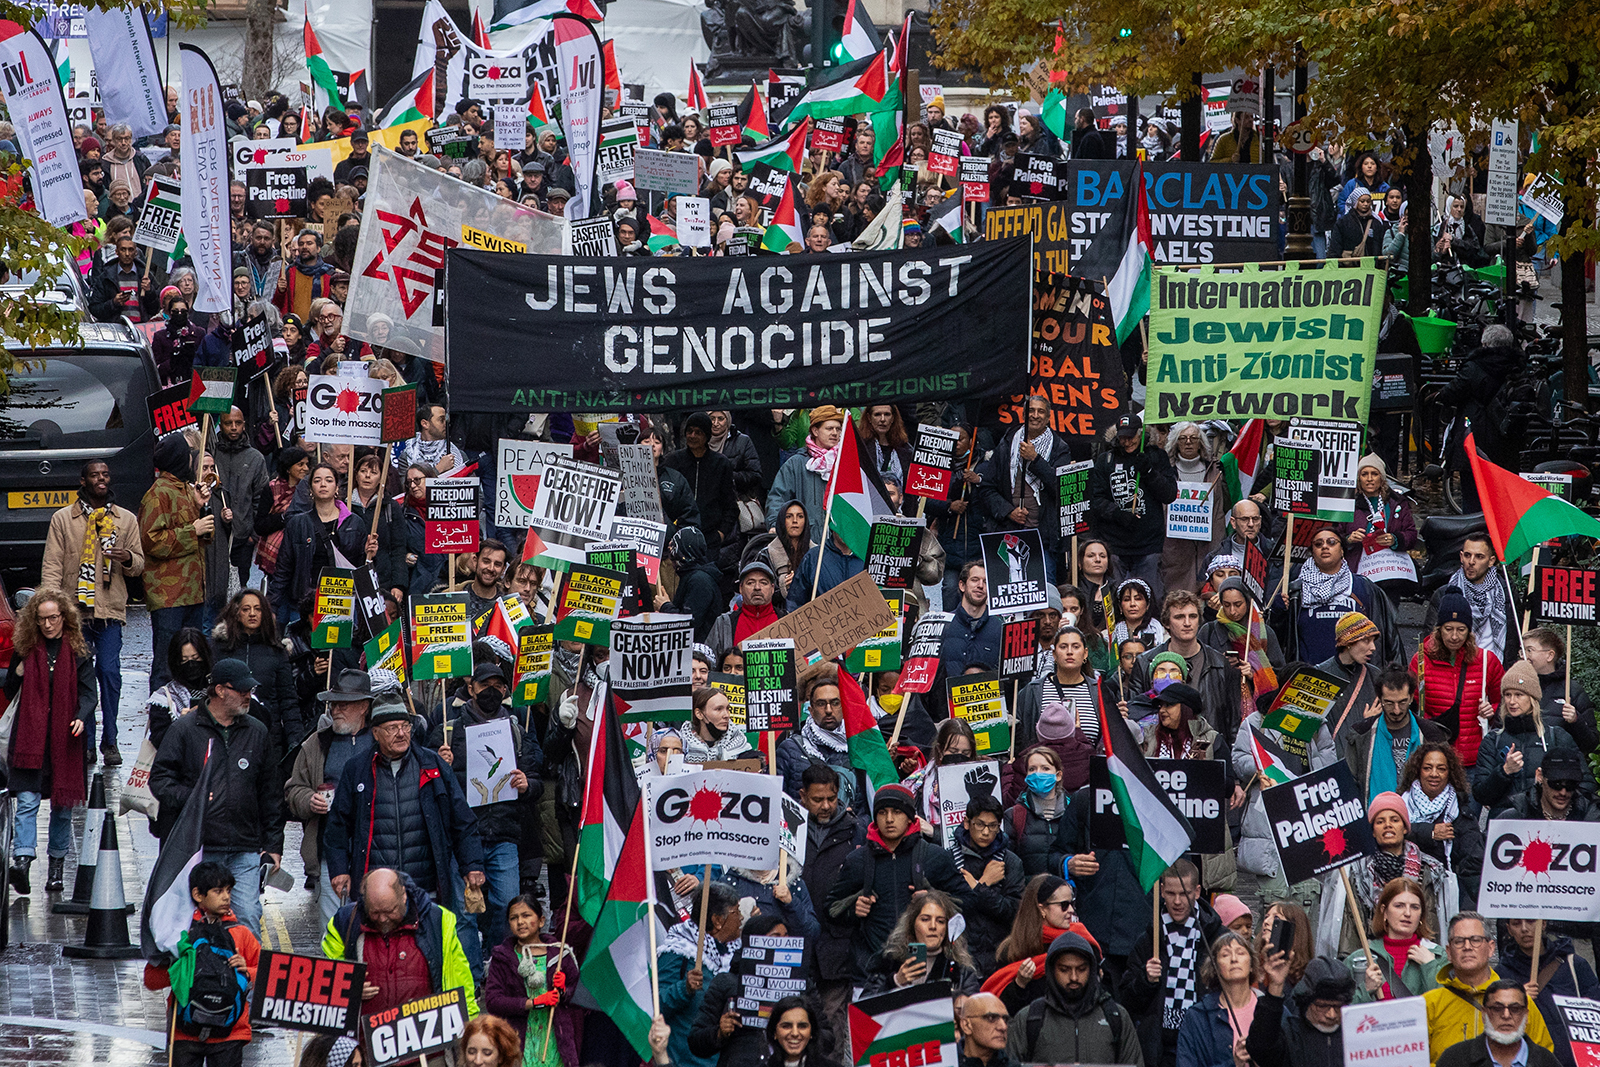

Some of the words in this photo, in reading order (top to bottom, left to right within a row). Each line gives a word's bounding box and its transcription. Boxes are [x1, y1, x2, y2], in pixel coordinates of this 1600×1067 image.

[124, 11, 136, 38] Jewish
[131, 39, 145, 74] Network
[140, 74, 148, 88] for
[144, 88, 157, 126] Palestine
[922, 87, 930, 96] NO
[28, 106, 53, 122] ALWAYS
[622, 107, 648, 116] FREEDOM
[710, 107, 736, 116] FREEDOM
[710, 117, 738, 127] PALESTINE
[816, 121, 844, 134] PALESTINE
[934, 134, 960, 146] FREEDOM
[1496, 132, 1502, 144] P
[931, 144, 960, 157] PALESTINE
[285, 154, 306, 162] STOP
[1028, 156, 1054, 172] Free
[962, 162, 988, 172] FREEDOM
[42, 172, 73, 188] oppressor
[266, 171, 296, 186] Free
[961, 172, 988, 182] PALESTINE
[249, 185, 306, 200] Palestine
[142, 204, 181, 230] FREE
[138, 221, 178, 238] PALESTINE
[464, 229, 525, 253] JEWISH
[525, 264, 676, 315] JEWS
[722, 254, 972, 315] AGAINST
[1159, 274, 1374, 310] International
[243, 320, 266, 344] Free
[1156, 314, 1364, 344] Jewish
[604, 317, 892, 374] GENOCIDE
[1040, 342, 1053, 353] the
[1156, 350, 1365, 384] Anti-Zionist
[511, 388, 632, 407] ANTI-NAZI
[644, 386, 808, 406] ANTI-FASCIST
[818, 372, 972, 400] ANTI-ZIONIST
[1158, 390, 1360, 420] Network
[153, 398, 196, 434] FREE
[310, 416, 330, 427] Stop
[332, 418, 346, 426] the
[348, 419, 381, 429] massac
[918, 434, 954, 452] FREEDOM
[620, 446, 634, 458] END
[638, 447, 651, 460] THE
[914, 450, 952, 468] PALESTINE
[1276, 446, 1296, 459] FROM
[1298, 449, 1313, 460] THE
[1276, 457, 1296, 470] RIVER
[1298, 460, 1308, 470] TO
[1276, 467, 1288, 480] THE
[1289, 470, 1304, 480] SEA
[543, 467, 618, 504] CEASEFIRE
[622, 476, 656, 490] CLEANSING
[1275, 478, 1314, 492] PALESTINE
[23, 492, 40, 505] S4
[44, 492, 69, 504] VAM
[430, 488, 474, 500] FREEDOM
[644, 491, 654, 500] THE
[544, 490, 606, 531] NOW!
[1060, 500, 1091, 517] PALESTINE
[1170, 503, 1210, 514] ISRAEL'S
[1274, 498, 1291, 511] FREE
[428, 506, 476, 519] PALESTINE
[1169, 513, 1210, 524] GENOCIDAL
[436, 524, 468, 536] الحرية
[616, 524, 660, 542] FREEDOM
[875, 524, 900, 537] FROM
[902, 527, 917, 538] THE
[1060, 526, 1075, 538] FREE
[1169, 524, 1188, 533] LAND
[1189, 526, 1209, 534] GRAB
[873, 534, 894, 546] RIVER
[896, 536, 910, 547] TO
[872, 544, 888, 555] THE
[888, 546, 904, 557] SEA
[869, 554, 913, 568] PALESTINE
[868, 564, 886, 576] WILL
[888, 566, 901, 577] BE
[325, 578, 348, 586] BLACK
[578, 574, 612, 588] BLACK
[996, 580, 1039, 596] FREE
[1542, 568, 1596, 604] FREE
[320, 587, 352, 596] LIBERATION:
[328, 598, 344, 606] FREE
[579, 592, 604, 606] FREE
[992, 590, 1046, 608] PALESTINE
[319, 606, 350, 614] PALESTINE!
[424, 606, 457, 614] BLACK
[566, 600, 612, 616] PALESTINE!
[1542, 602, 1596, 620] PALESTINE
[416, 614, 466, 622] LIBERATION:
[430, 626, 454, 634] FREE
[526, 634, 548, 645] BLACK
[613, 630, 690, 654] CEASEFIRE
[746, 642, 768, 650] Socialist
[1004, 620, 1036, 659] FREE
[746, 651, 769, 664] FROM
[771, 650, 788, 664] THE
[621, 650, 682, 680] NOW!
[747, 664, 772, 678] RIVER
[772, 664, 784, 676] TO
[1002, 654, 1034, 676] PALESTINE
[747, 678, 765, 691] THE
[766, 677, 782, 690] SEA
[959, 682, 992, 694] BLACK
[1302, 674, 1332, 691] BLACK
[748, 689, 792, 704] PALESTINE
[953, 690, 1000, 704] LIBERATION:
[1291, 680, 1334, 700] LIBERATION:
[1282, 696, 1323, 715] PALESTINE!
[1296, 691, 1319, 706] FREE
[748, 703, 768, 716] WILL
[770, 702, 782, 716] BE
[966, 702, 990, 714] FREE
[748, 716, 768, 730] FREE
[478, 730, 502, 738] #FREEDOM
[1293, 776, 1340, 812] Free
[1275, 798, 1364, 848] Palestine
[655, 834, 681, 847] Stop
[684, 830, 703, 842] the
[706, 830, 770, 846] massacre
[1486, 881, 1512, 894] Stop
[1515, 882, 1534, 893] the
[1536, 884, 1596, 896] massacre
[762, 938, 783, 948] YOU
[784, 940, 804, 948] ARE
[743, 949, 764, 958] PRO
[758, 966, 790, 976] TODAY
[265, 953, 355, 1008] FREE
[743, 976, 764, 986] YOU
[768, 980, 806, 990] WOULD
[369, 1007, 400, 1028] STOP
[401, 990, 460, 1017] BOMBING
[738, 1000, 758, 1010] PRO
[261, 997, 348, 1030] PALESTINE
[743, 1018, 762, 1026] THE
[370, 1004, 466, 1064] GAZA
[869, 1039, 942, 1067] FREE
[1349, 1041, 1425, 1062] HEALTHCARE
